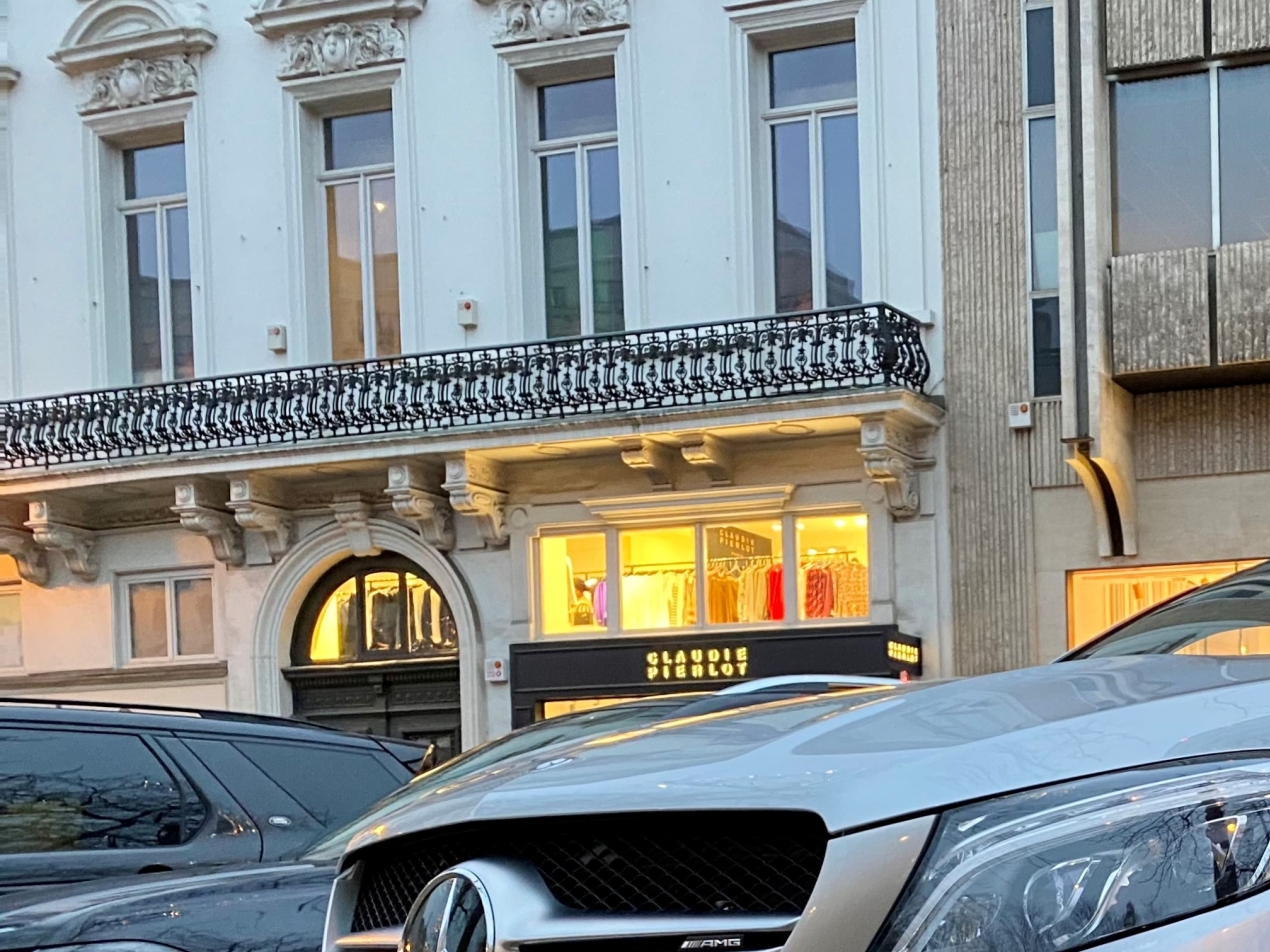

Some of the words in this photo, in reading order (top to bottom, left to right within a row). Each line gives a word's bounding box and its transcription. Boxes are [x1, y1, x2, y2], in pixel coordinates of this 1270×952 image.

[719, 529, 755, 546] CLAUDIE
[719, 537, 755, 554] PIERLOT
[646, 647, 748, 665] CLAUDIE
[646, 662, 748, 680] PIERLOT
[700, 938, 741, 948] AMG
